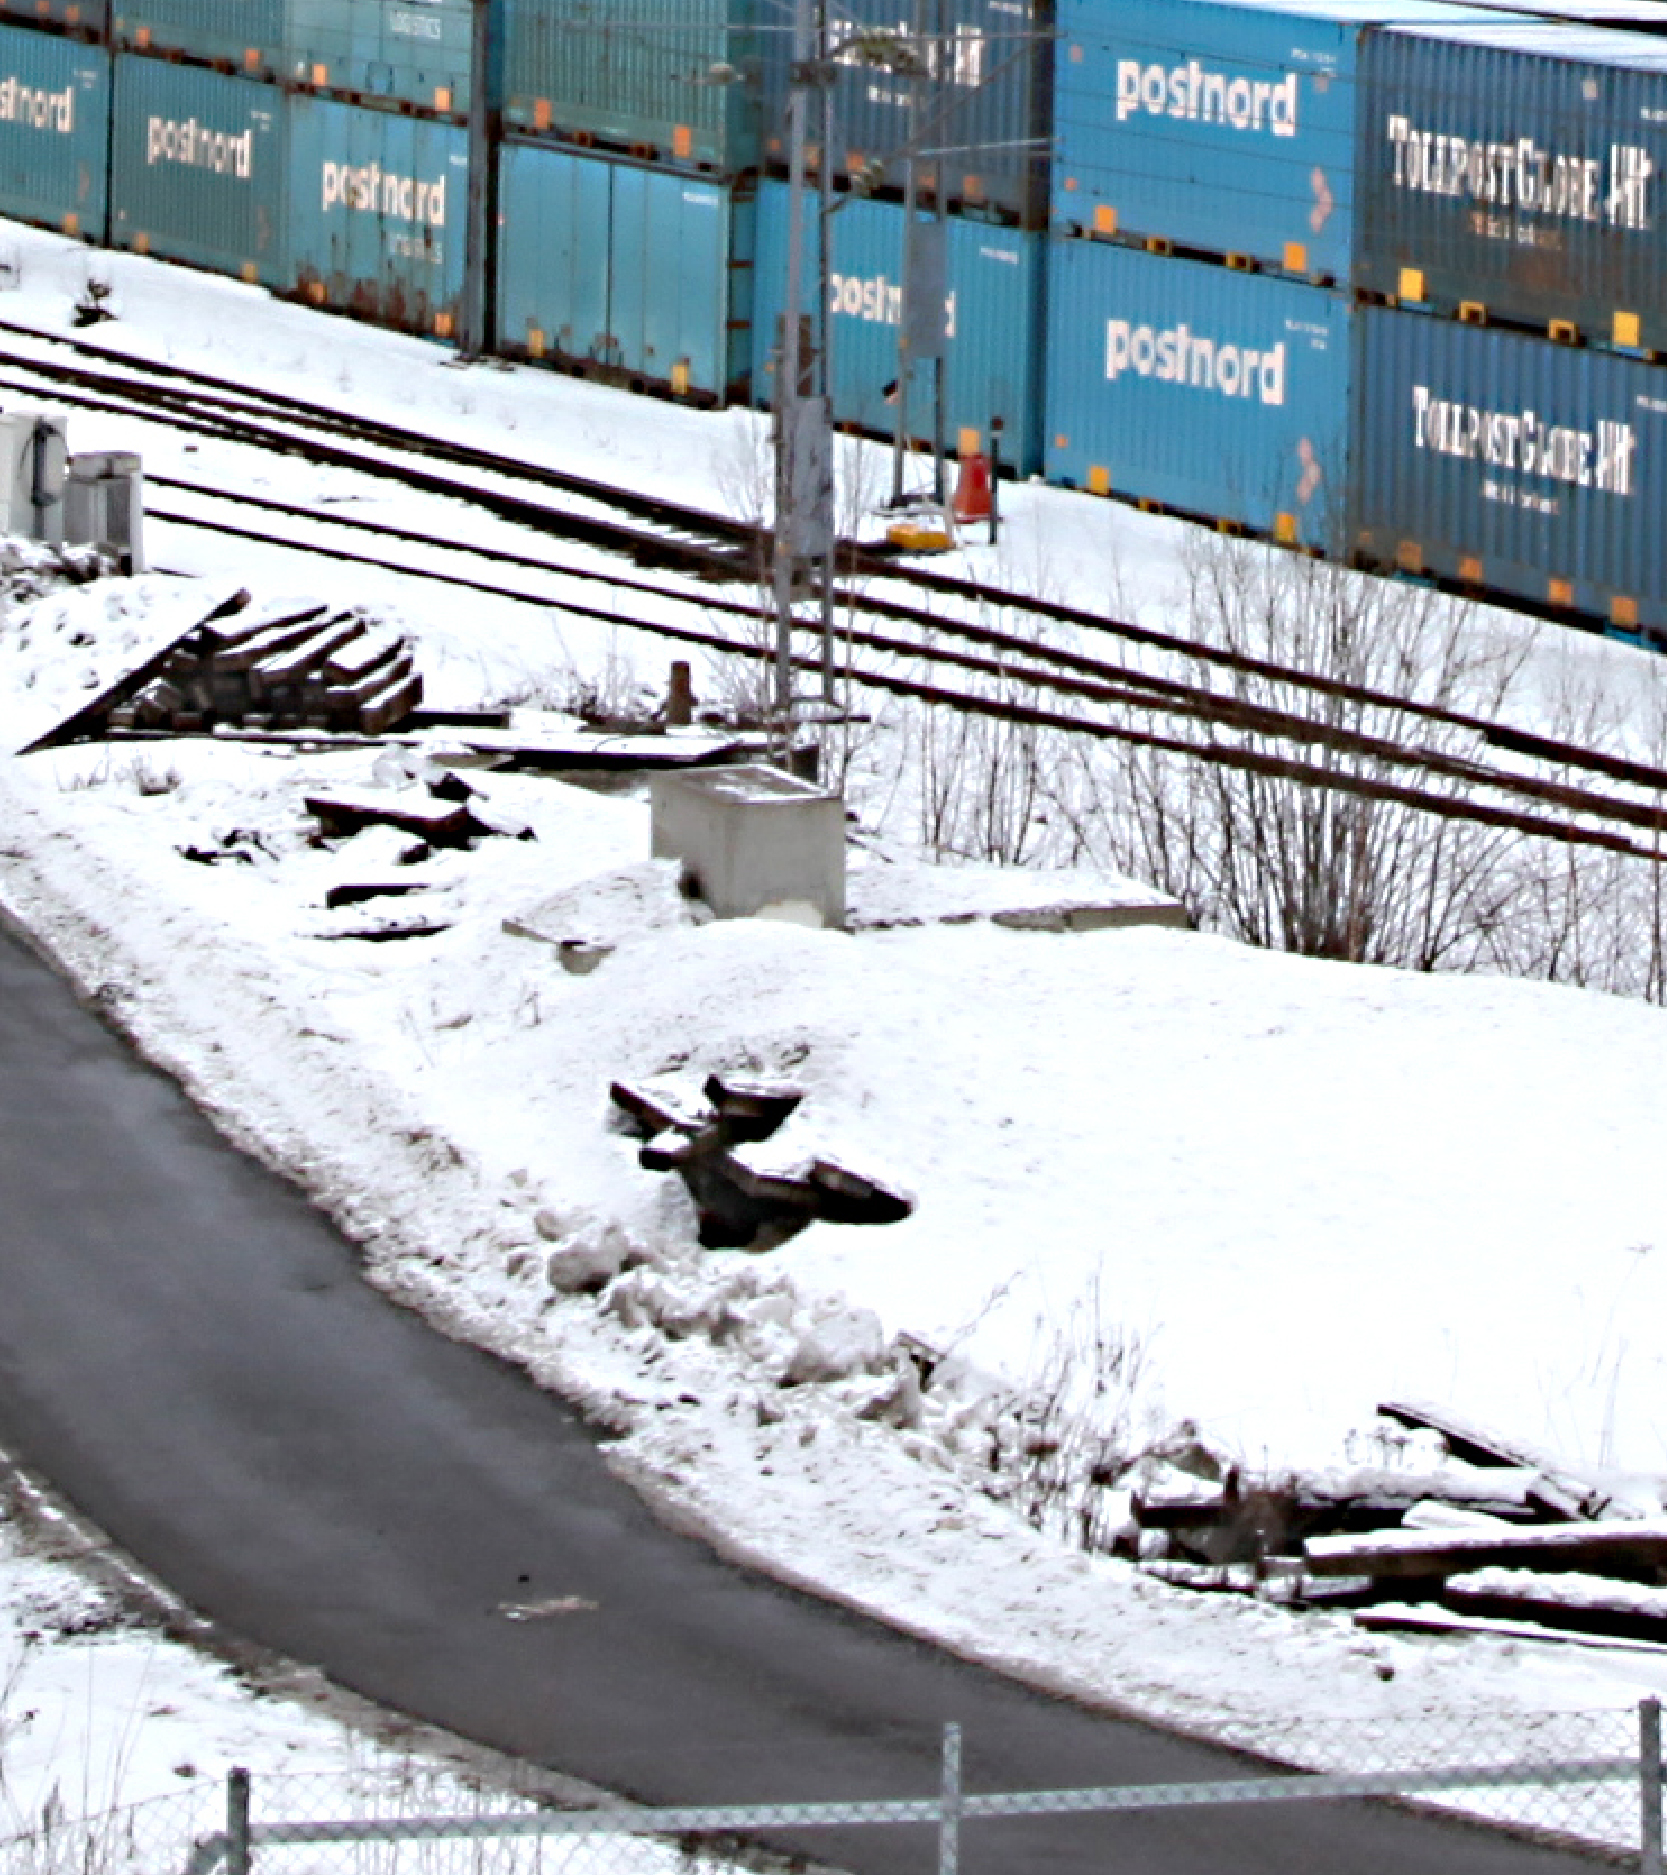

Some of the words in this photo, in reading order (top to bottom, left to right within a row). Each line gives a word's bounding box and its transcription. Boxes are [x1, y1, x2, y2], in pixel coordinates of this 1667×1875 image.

[1117, 59, 1297, 138] postnord
[147, 116, 252, 178] postnord
[322, 160, 445, 226] postnord
[1106, 320, 1285, 405] postnord
